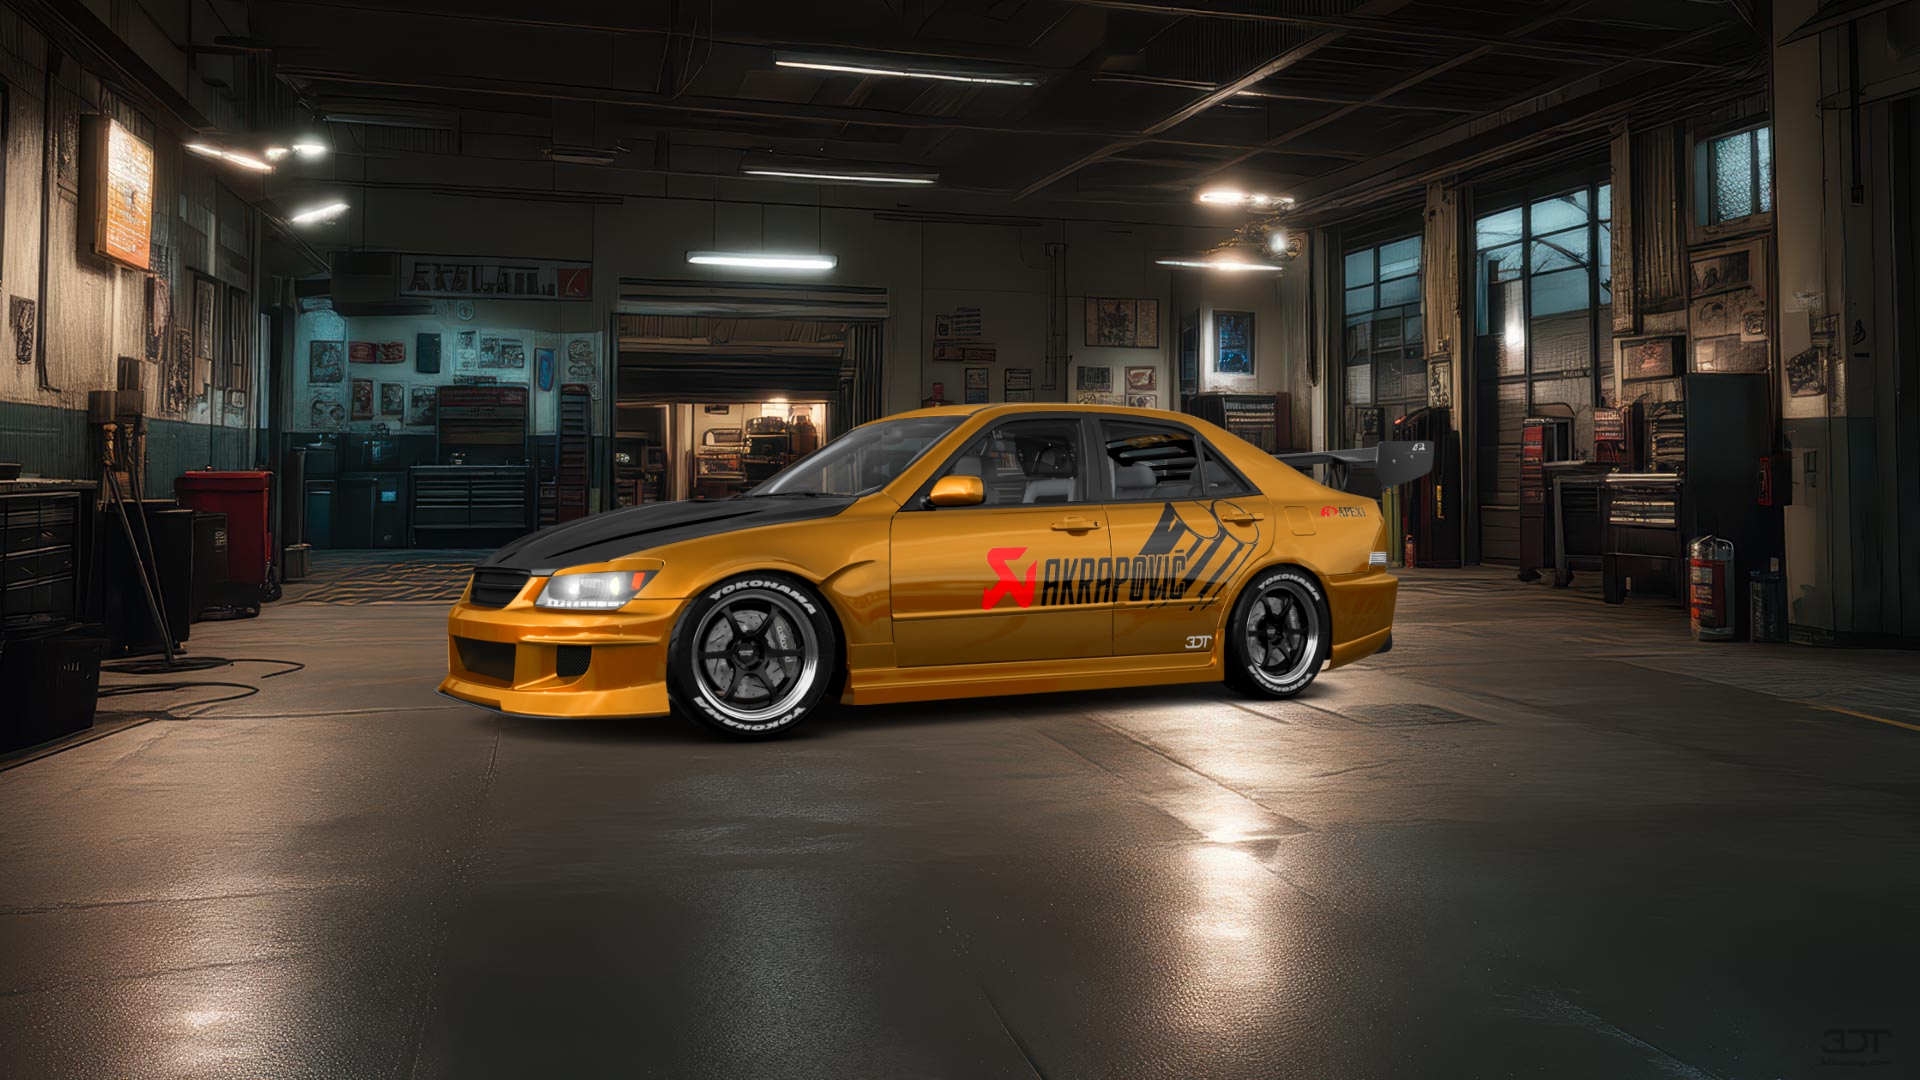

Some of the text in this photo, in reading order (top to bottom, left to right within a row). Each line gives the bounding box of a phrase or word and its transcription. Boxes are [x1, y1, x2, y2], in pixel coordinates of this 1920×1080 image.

[709, 580, 817, 615] YOKOHAMA
[1258, 573, 1320, 602] YOKOHAMA
[1185, 635, 1213, 649] 3DT
[1248, 664, 1313, 692] YOKOHAMA
[693, 696, 806, 731] YOKOHAMA
